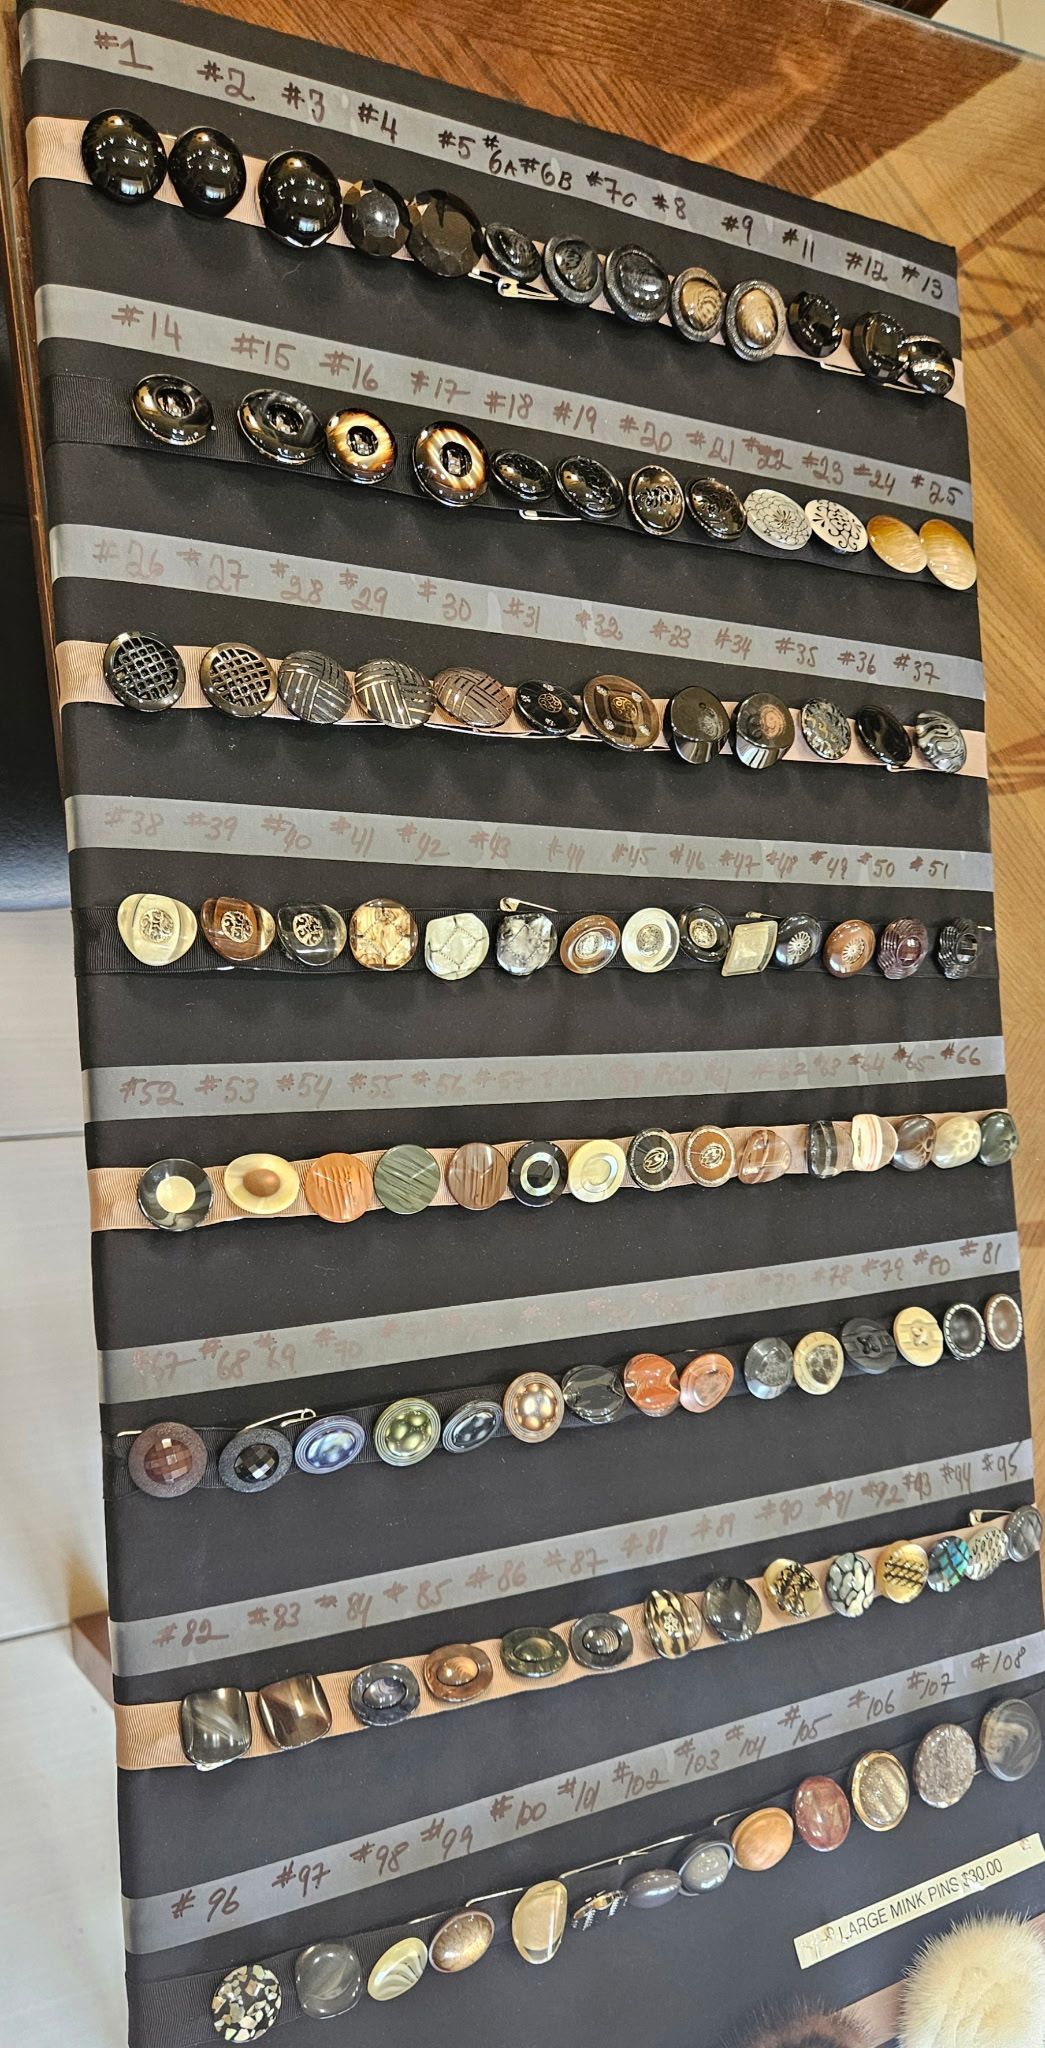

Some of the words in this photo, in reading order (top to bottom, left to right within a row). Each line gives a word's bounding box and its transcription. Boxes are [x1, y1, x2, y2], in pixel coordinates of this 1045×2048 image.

[94, 29, 153, 71] #1
[197, 60, 255, 102] #2
[282, 82, 325, 123] #3
[357, 103, 398, 143] #4
[438, 130, 476, 160] #5
[482, 134, 517, 177] #6A
[518, 156, 573, 190] #6B
[652, 193, 687, 220] #8
[720, 214, 755, 246] #9
[781, 228, 815, 263] #11
[845, 250, 888, 283] #12
[901, 263, 945, 300] #13
[111, 303, 183, 352] #14
[231, 332, 296, 371] #15
[318, 350, 379, 392] #16
[410, 370, 470, 404] #17
[483, 390, 534, 420] #18
[553, 400, 597, 434] #19
[619, 414, 673, 454] #20
[686, 430, 735, 466] #21
[801, 450, 844, 485] #23
[853, 463, 897, 496] #24
[910, 473, 963, 506] #25
[92, 538, 164, 578] #26
[176, 548, 249, 593] #27
[269, 558, 323, 605] #28
[338, 568, 388, 616] #29
[417, 578, 472, 622] #30
[503, 597, 541, 633] #31
[575, 609, 624, 641] #32
[649, 618, 692, 648] #33
[714, 627, 752, 660] #34
[775, 637, 819, 668] #35
[837, 650, 877, 675] #36
[892, 653, 941, 685] #37
[104, 805, 164, 837] #38
[184, 811, 238, 841] #39
[261, 813, 312, 852] #40
[329, 816, 376, 857] #41
[396, 822, 450, 861] #42
[611, 843, 656, 867] #45
[719, 850, 760, 878] #47
[809, 850, 848, 880] #49
[857, 852, 896, 878] #50
[909, 856, 949, 880] #51
[119, 1076, 184, 1106] #52
[194, 1074, 258, 1104] #53
[276, 1072, 333, 1109] #54
[348, 1071, 403, 1100] #55
[892, 1044, 935, 1072] #65
[940, 1042, 982, 1066] #66
[199, 1337, 250, 1381] #68
[861, 1257, 905, 1282] #79
[959, 1239, 1002, 1265] #81
[152, 1619, 229, 1647] #82
[247, 1602, 301, 1631] #83
[315, 1592, 373, 1628] #84
[383, 1578, 452, 1610] #85
[465, 1560, 527, 1592] #86
[543, 1548, 608, 1575] #87
[621, 1525, 667, 1560] #88
[691, 1511, 736, 1540] #89
[755, 1499, 803, 1525] #90
[814, 1486, 854, 1518] #91
[902, 1471, 931, 1500] #93
[939, 1462, 972, 1495] #94
[981, 1441, 1023, 1481] #95
[171, 1886, 240, 1922] #96
[272, 1861, 331, 1897] #97
[350, 1841, 409, 1877] #98
[420, 1818, 473, 1859] #99
[490, 1795, 547, 1830] #100
[557, 1777, 599, 1812] #101
[612, 1761, 669, 1799] #102
[674, 1738, 720, 1776] #103
[725, 1724, 766, 1760] #104
[777, 1704, 832, 1746] #105
[848, 1689, 895, 1721] #106
[907, 1670, 955, 1699] #107
[970, 1646, 1026, 1673] #108
[838, 1907, 888, 1944] LARGE
[889, 1891, 927, 1919] MINK
[928, 1877, 960, 1908] PINS
[961, 1858, 1004, 1888] $30.00
